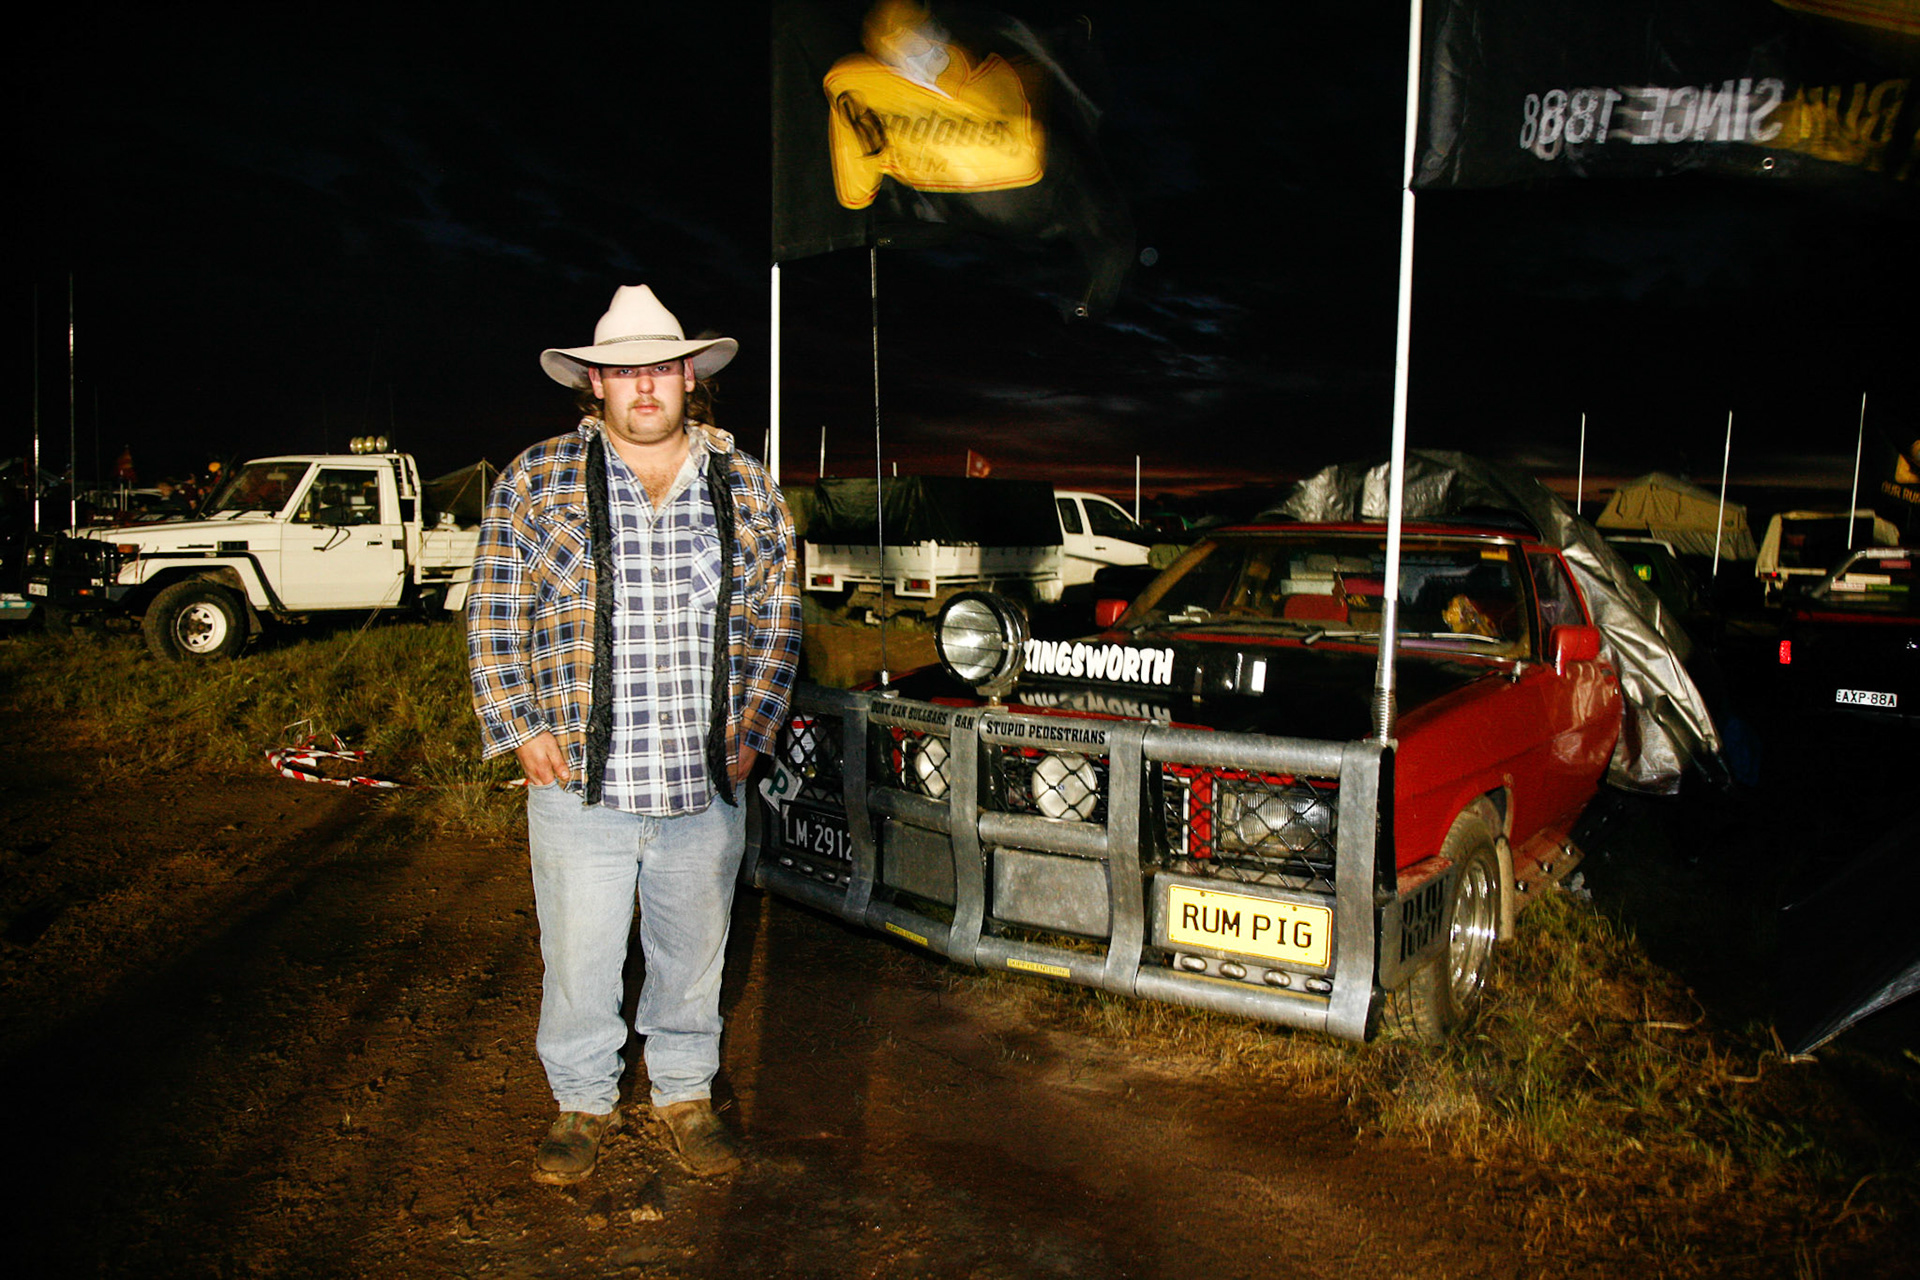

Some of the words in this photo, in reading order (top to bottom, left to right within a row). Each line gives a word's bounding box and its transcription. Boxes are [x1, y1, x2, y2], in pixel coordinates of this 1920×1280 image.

[891, 704, 908, 719] BAN
[908, 707, 949, 726] BULLBARS
[954, 714, 975, 730] BAN
[986, 720, 1026, 738] STUPID
[1028, 724, 1106, 745] PEDESTRIANS
[768, 767, 789, 797] P
[1182, 902, 1241, 938] RUM
[1251, 913, 1313, 950] PIG
